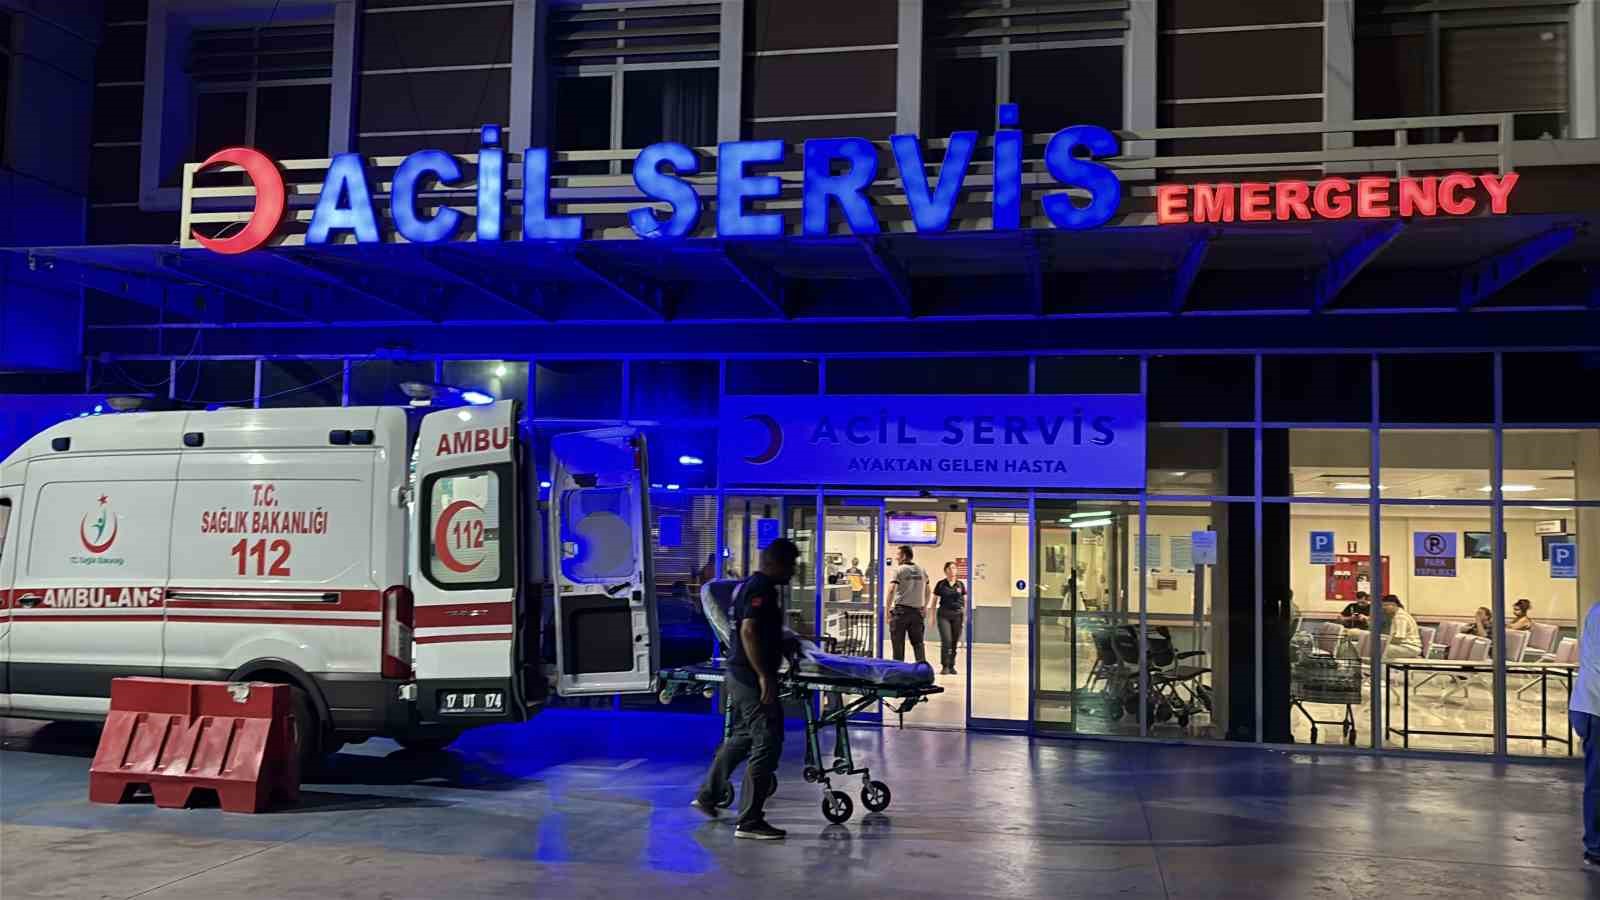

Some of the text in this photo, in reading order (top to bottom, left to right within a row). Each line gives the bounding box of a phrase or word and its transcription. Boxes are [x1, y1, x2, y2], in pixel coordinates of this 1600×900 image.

[304, 103, 1123, 245] ACİL SERVİS
[1156, 172, 1520, 225] EMERGENCY
[809, 407, 1116, 446] ACİL SERVİS
[436, 427, 509, 456] AMBU
[847, 457, 1067, 473] AYAKTAN GELEN HASTA
[253, 484, 278, 506] T.C.
[201, 506, 328, 534] SAĞLIK BAKANLIĞI
[453, 519, 484, 549] 112
[1315, 535, 1328, 550] P
[1555, 548, 1570, 564] P
[231, 538, 291, 576] 112
[43, 587, 162, 608] AMBULANS
[446, 694, 457, 708] 17
[485, 693, 502, 709] 174
